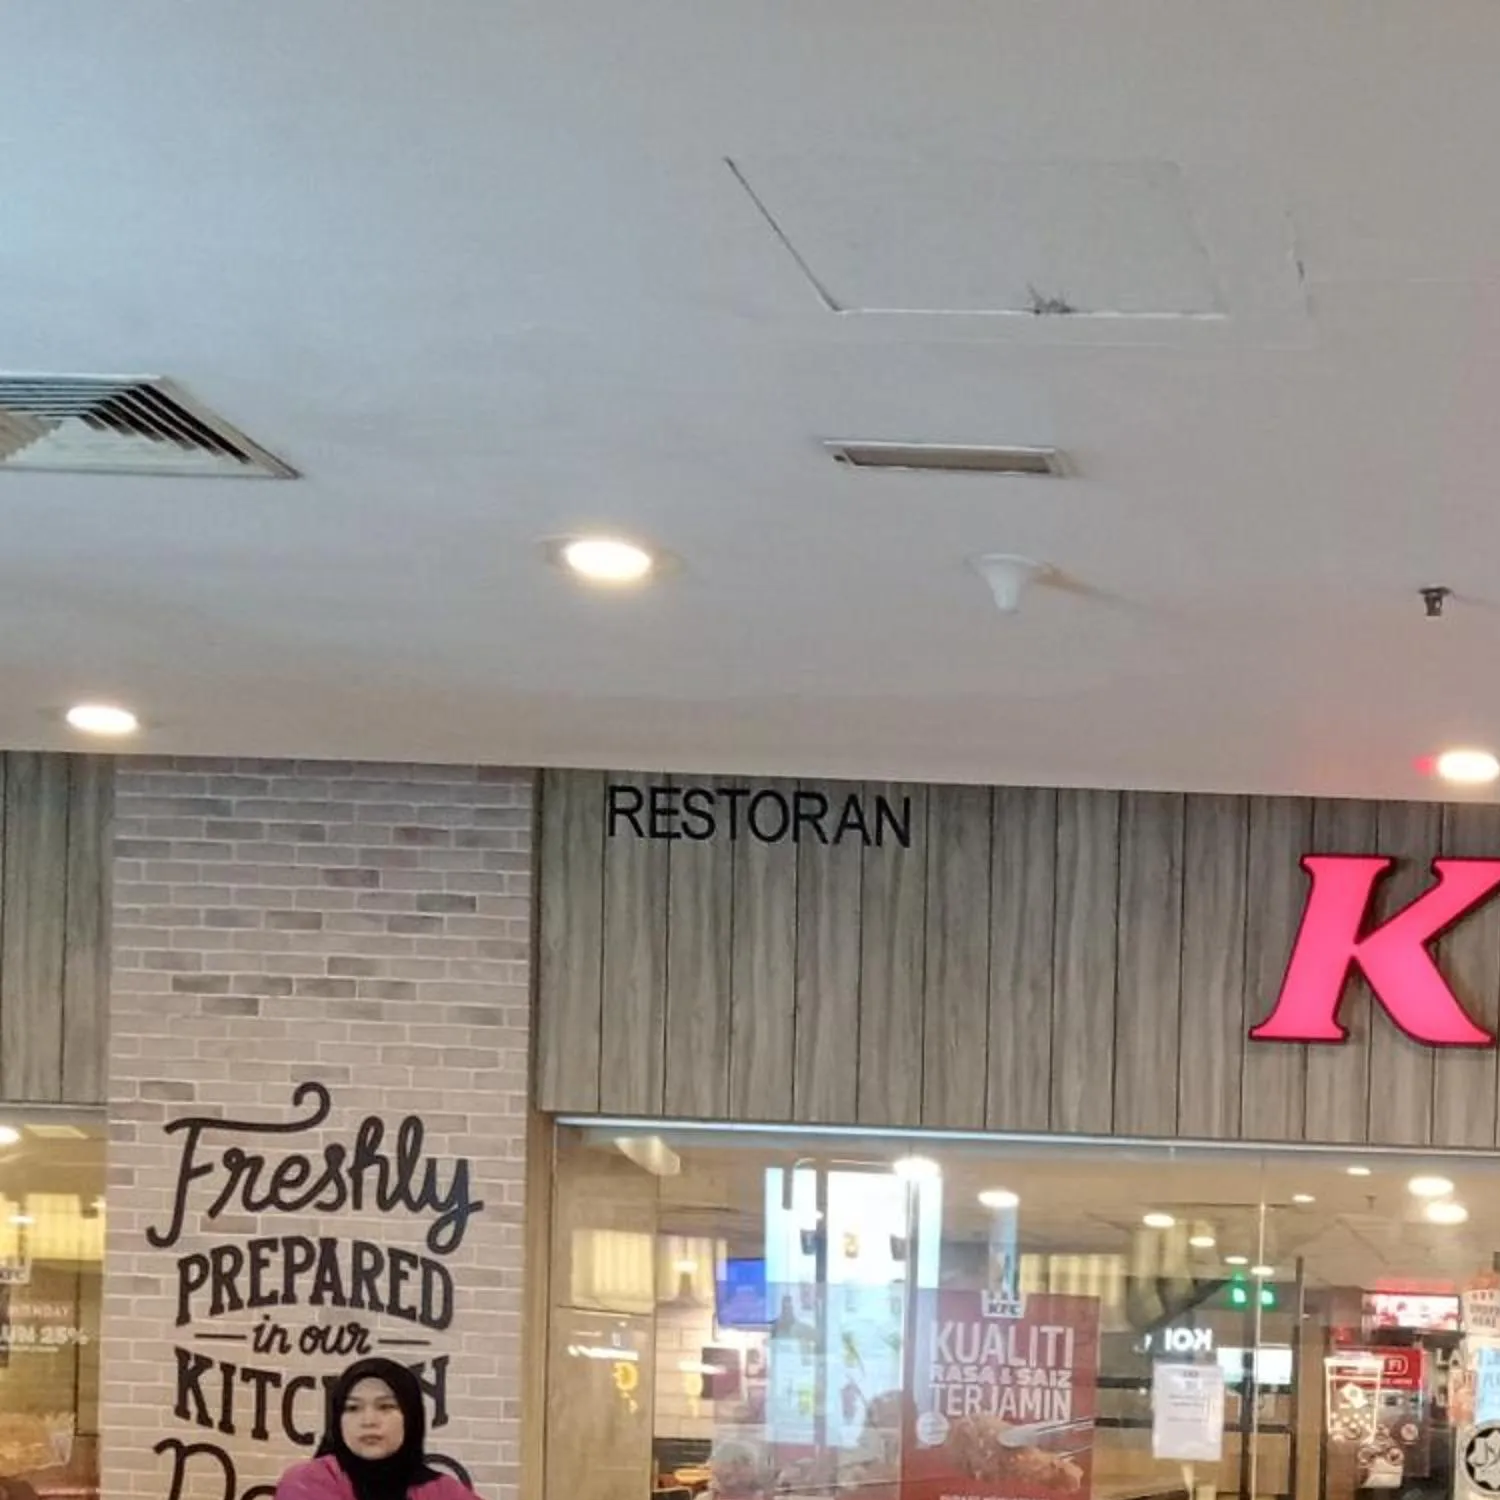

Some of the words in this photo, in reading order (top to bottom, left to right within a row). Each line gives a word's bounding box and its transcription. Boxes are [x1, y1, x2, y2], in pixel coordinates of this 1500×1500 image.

[607, 785, 911, 848] RESTORAN
[147, 1081, 484, 1255] Freshly
[174, 1235, 455, 1332] PREPARED
[252, 1313, 292, 1355] in
[299, 1320, 373, 1357] our
[931, 1321, 1074, 1369] KUALITI
[174, 1345, 450, 1446] KITCN
[929, 1383, 1072, 1421] TERJAMIN
[931, 1364, 996, 1386] RASA
[1016, 1368, 1073, 1388] SAIZ
